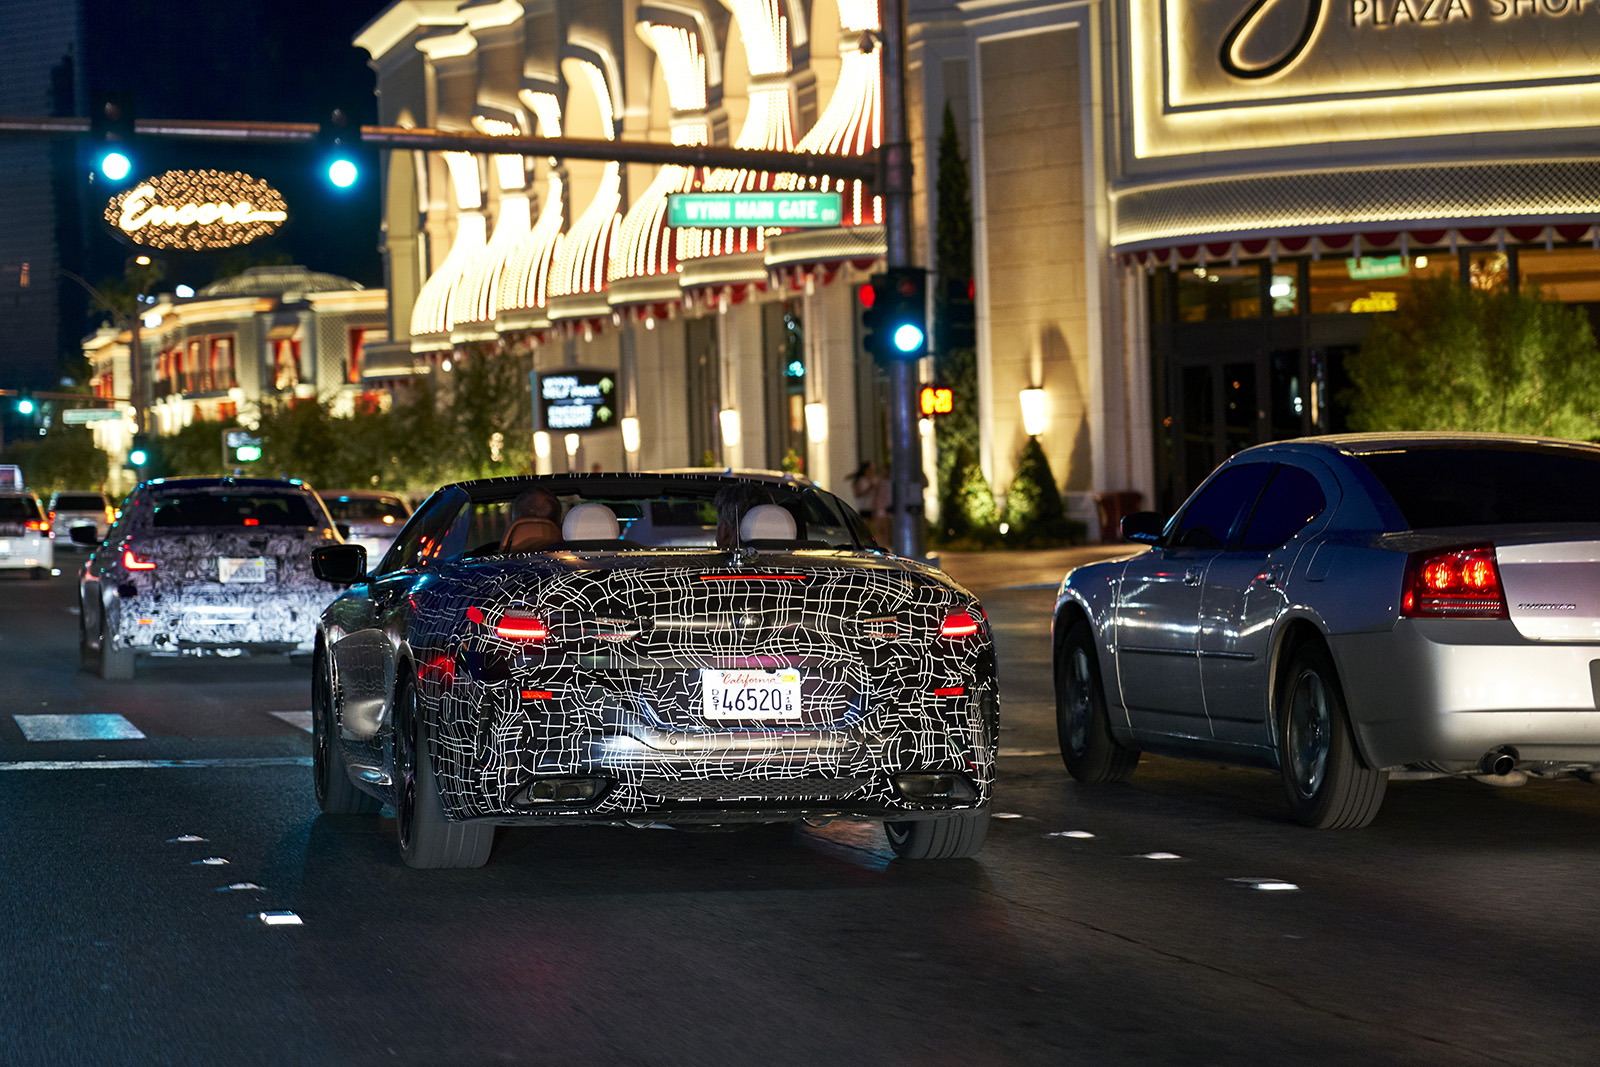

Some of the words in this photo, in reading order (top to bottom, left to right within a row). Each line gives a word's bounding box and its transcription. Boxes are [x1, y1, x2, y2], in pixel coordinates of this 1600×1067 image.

[1351, 0, 1469, 28] PLAZA
[1490, 0, 1600, 20] SHO
[119, 185, 287, 231] Encore
[685, 201, 731, 219] WYNN
[735, 201, 774, 219] MAIN
[778, 200, 818, 219] GATE
[723, 673, 781, 687] California
[722, 688, 782, 711] 46520
